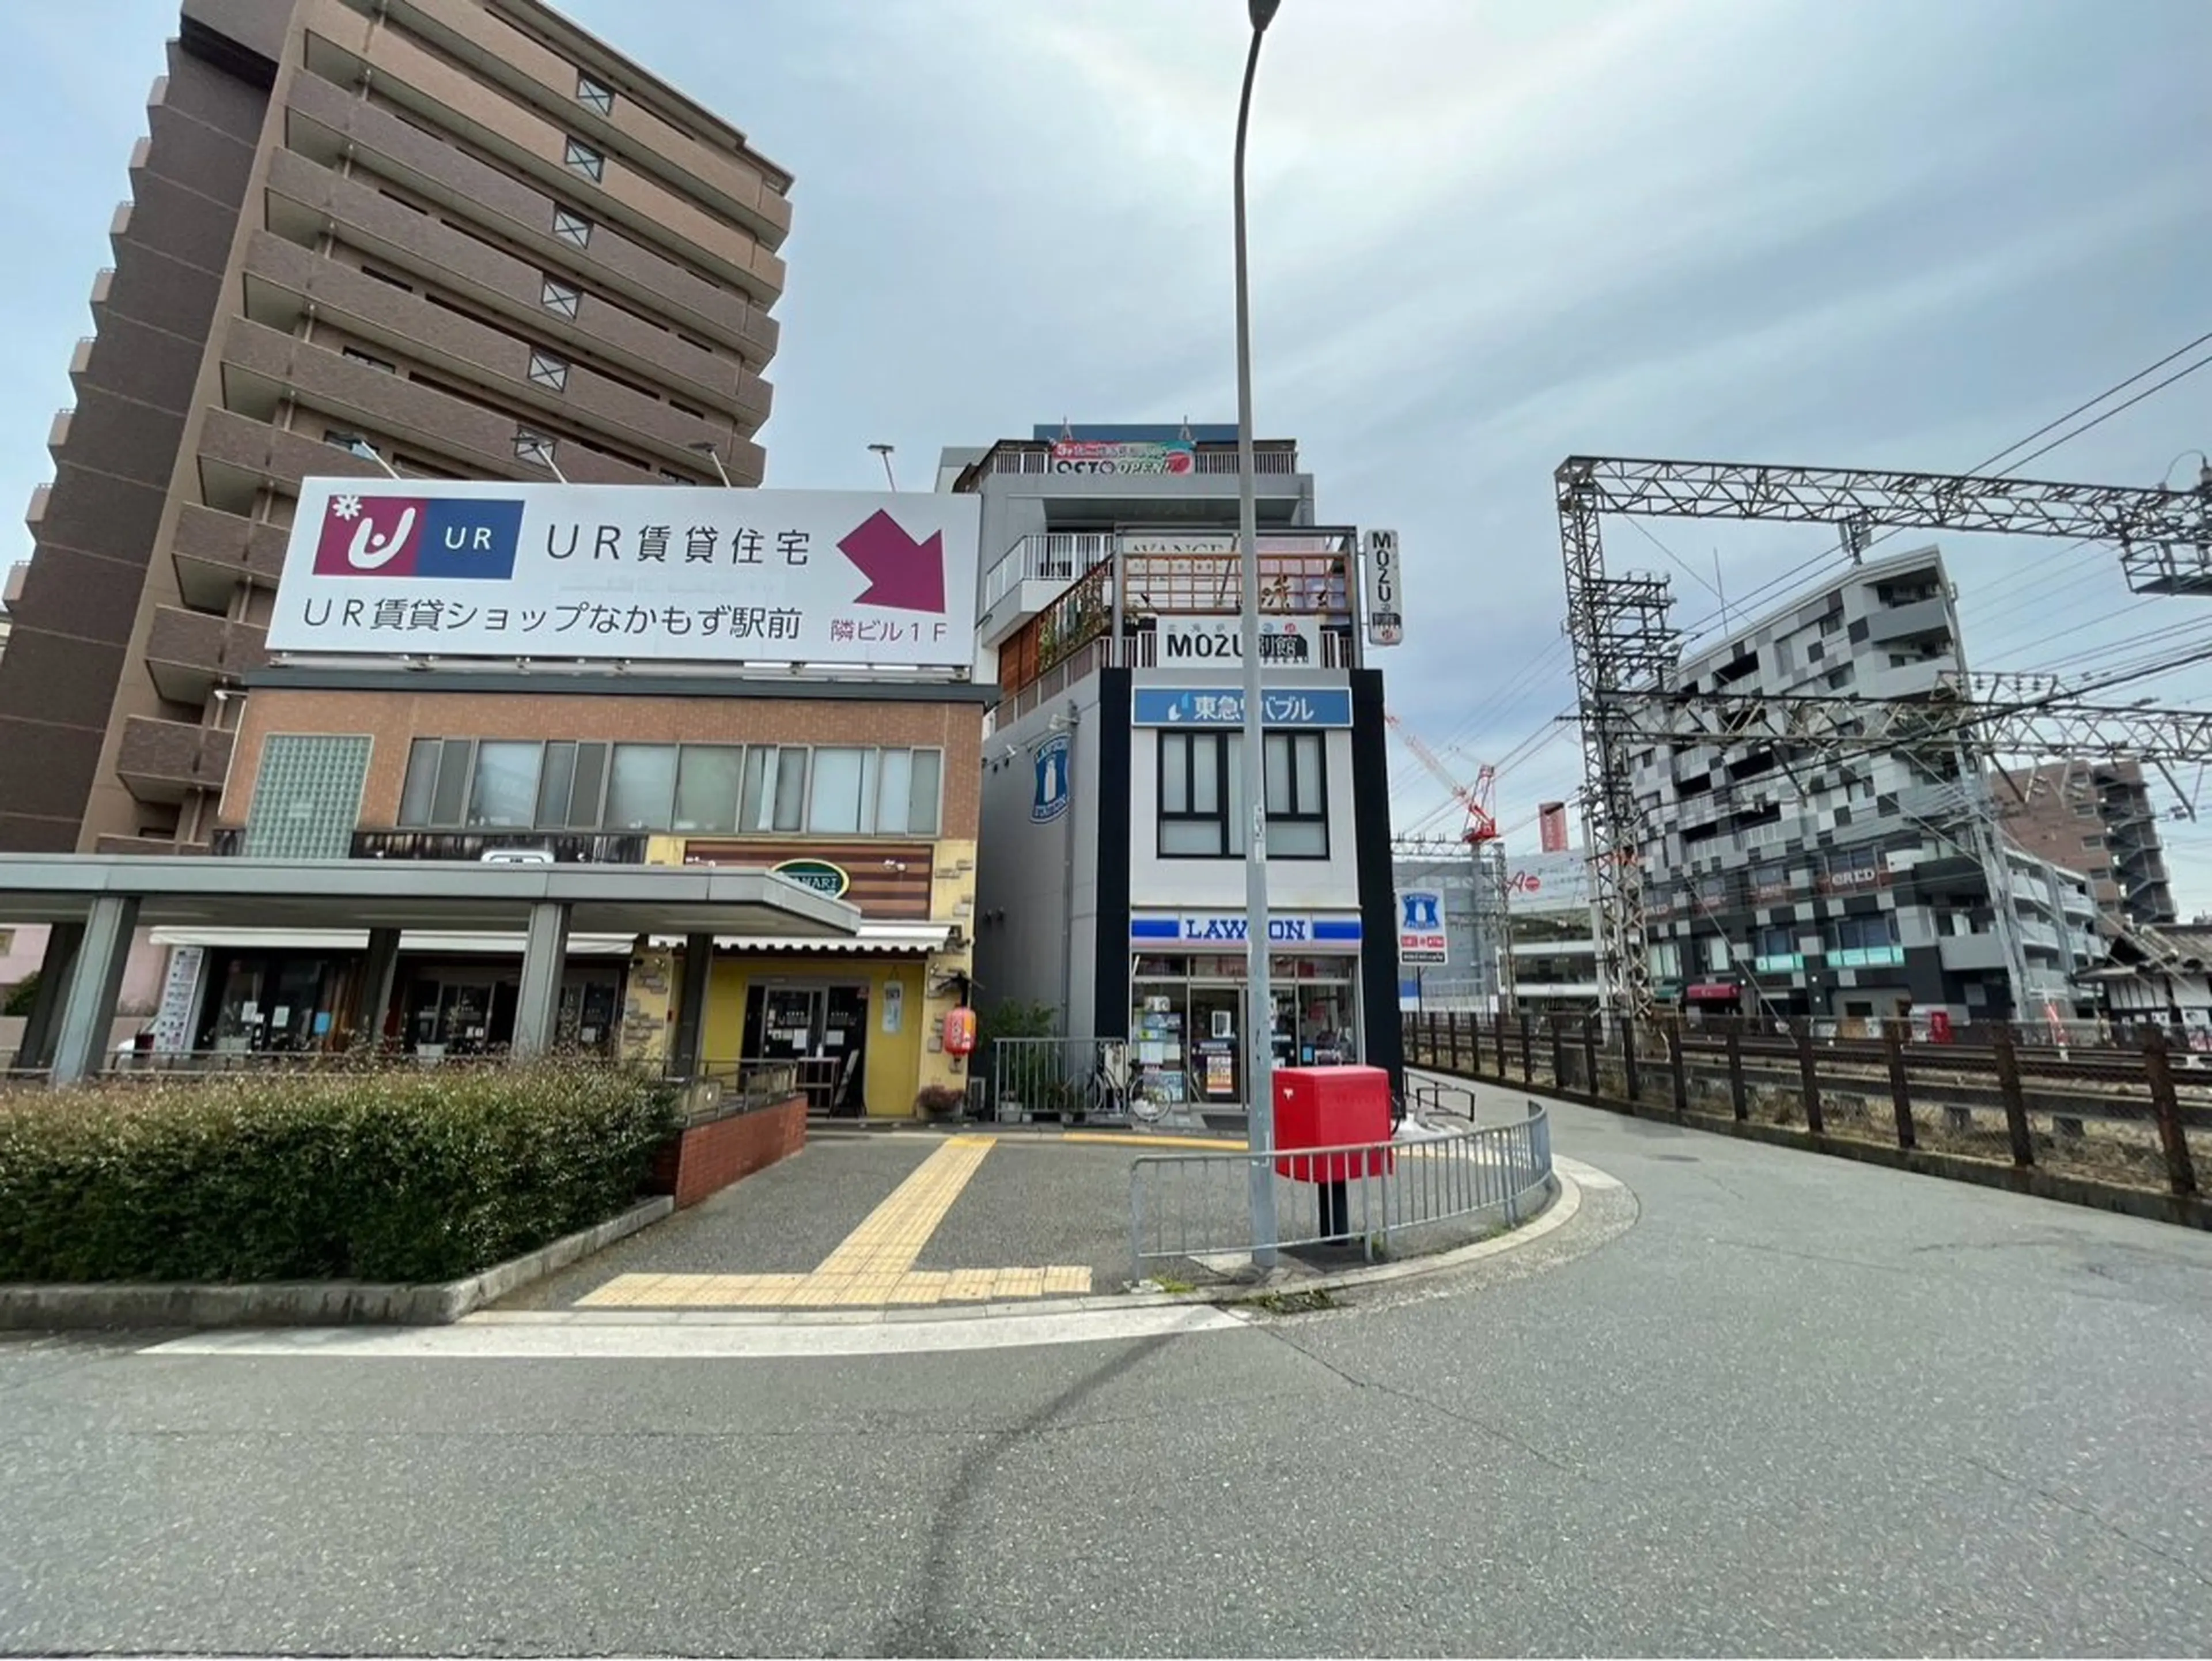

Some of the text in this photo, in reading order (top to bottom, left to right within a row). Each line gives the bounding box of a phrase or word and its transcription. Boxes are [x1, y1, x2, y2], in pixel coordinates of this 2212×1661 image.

[445, 526, 493, 551] UR
[547, 524, 810, 566] UR賃貸住宅
[302, 599, 803, 640] UR賃貸ショップなかもず駅前
[1185, 920, 1305, 940] LAWON
